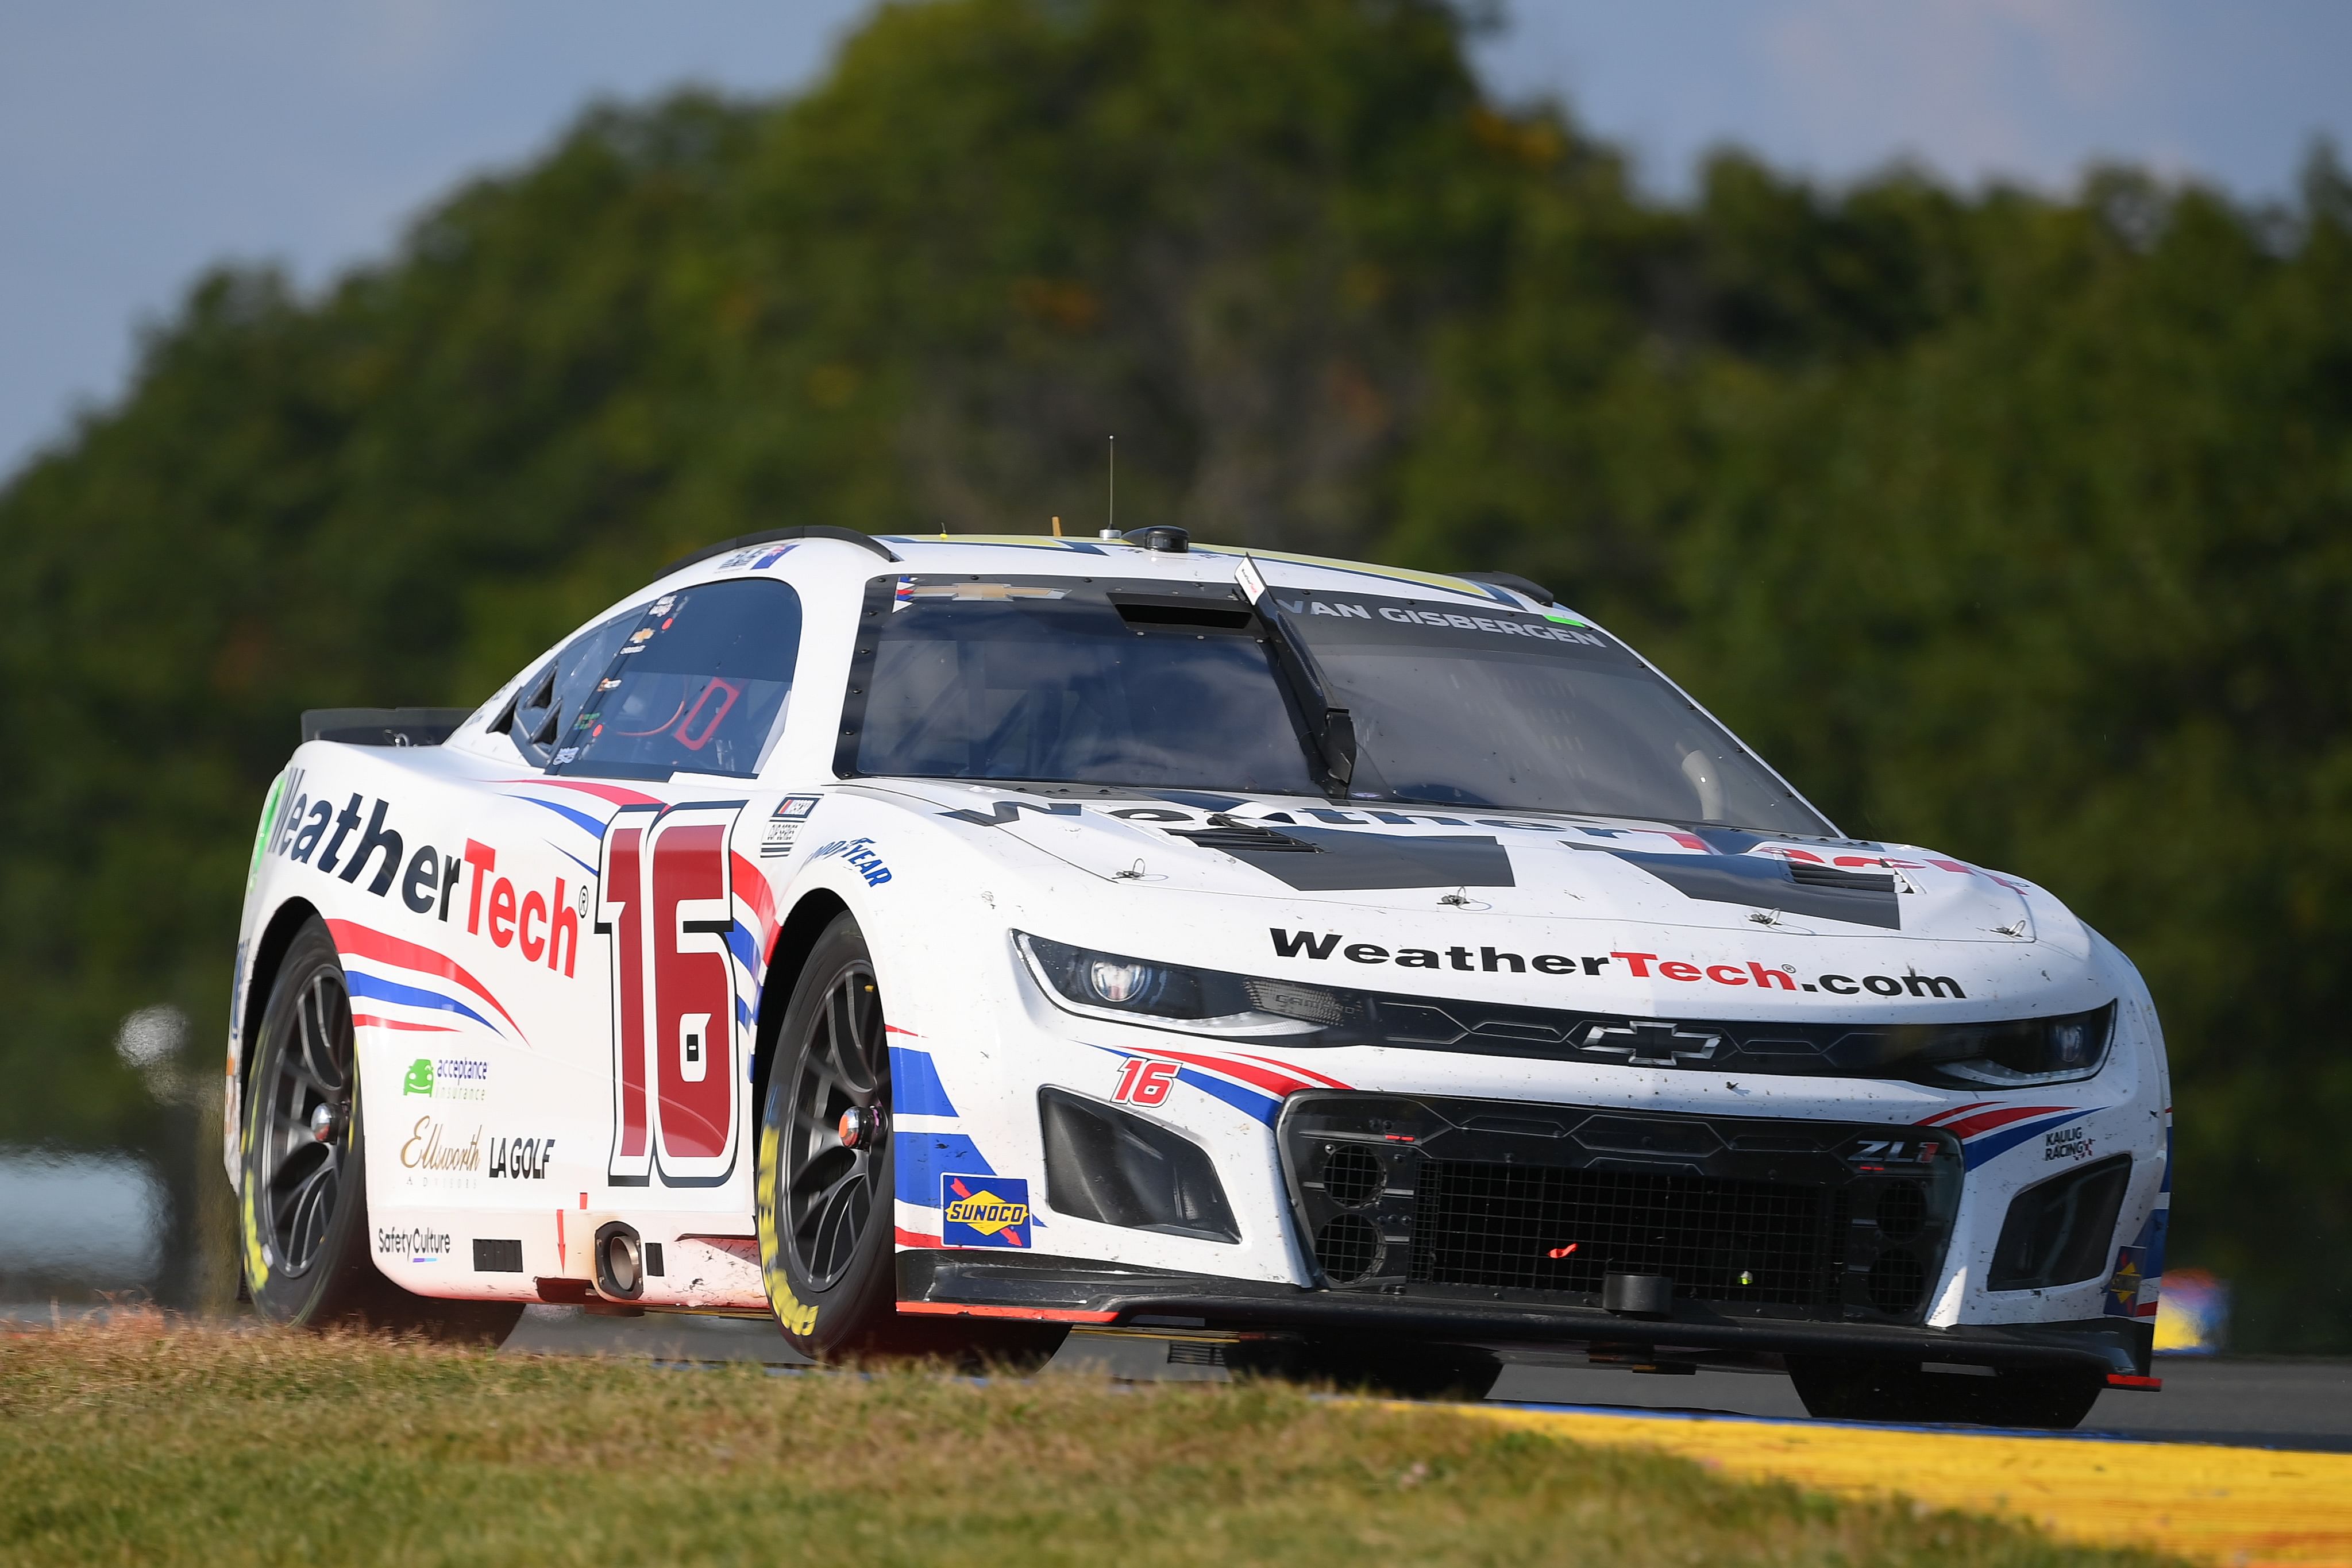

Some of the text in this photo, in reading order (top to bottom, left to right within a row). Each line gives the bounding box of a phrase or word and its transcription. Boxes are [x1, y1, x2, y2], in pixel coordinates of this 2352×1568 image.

[1276, 598, 1607, 648] VAN GISBERGEN
[595, 800, 750, 1187] 16
[437, 1057, 488, 1086] acceptance
[1110, 1056, 1182, 1107] 16
[401, 1115, 481, 1172] Ellsworth
[1848, 1140, 1940, 1163] ZL1
[2044, 1141, 2084, 1161] RACING
[2045, 1126, 2082, 1146] KAULIG
[489, 1137, 556, 1179] LA GOLF
[950, 1203, 1025, 1222] SUNOCO
[379, 1226, 451, 1262] SafetyCulture
